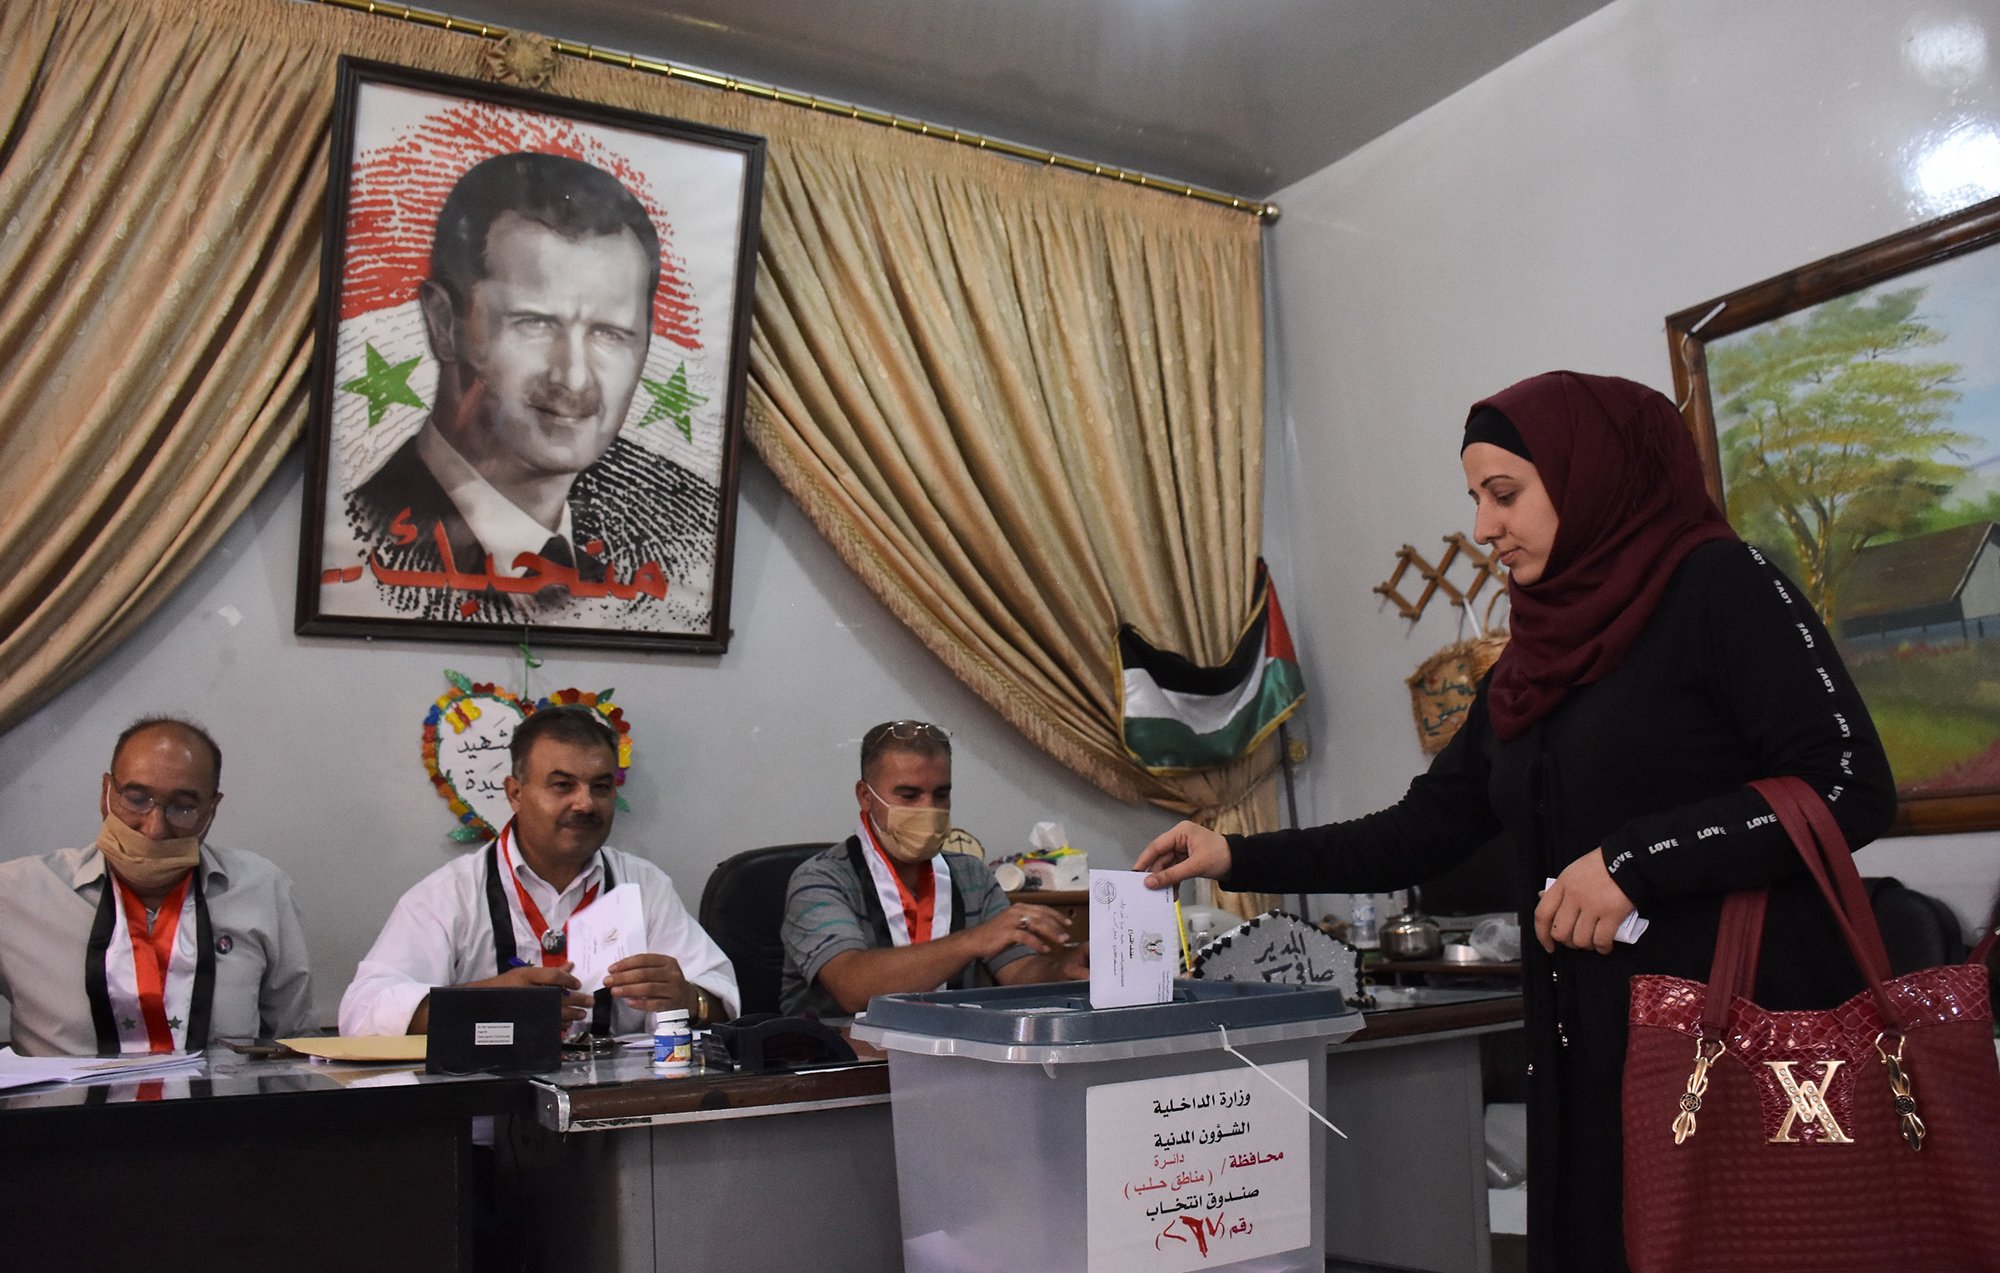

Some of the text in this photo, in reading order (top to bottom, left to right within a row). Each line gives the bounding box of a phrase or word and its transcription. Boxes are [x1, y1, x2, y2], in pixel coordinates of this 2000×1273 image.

[1773, 580, 1793, 604] LOVE
[1795, 622, 1815, 648] LOVE
[1815, 667, 1835, 693] LOVE
[1607, 814, 1777, 873] LOVE LOVE LOVE LOVE
[1254, 931, 1307, 964] المدير
[1153, 1090, 1251, 1118] وزارة الداخلية
[1154, 1121, 1250, 1151] الشؤون المدنية
[1146, 1186, 1260, 1221] صندوق انتخاب
[1229, 1217, 1253, 1238] رقم
